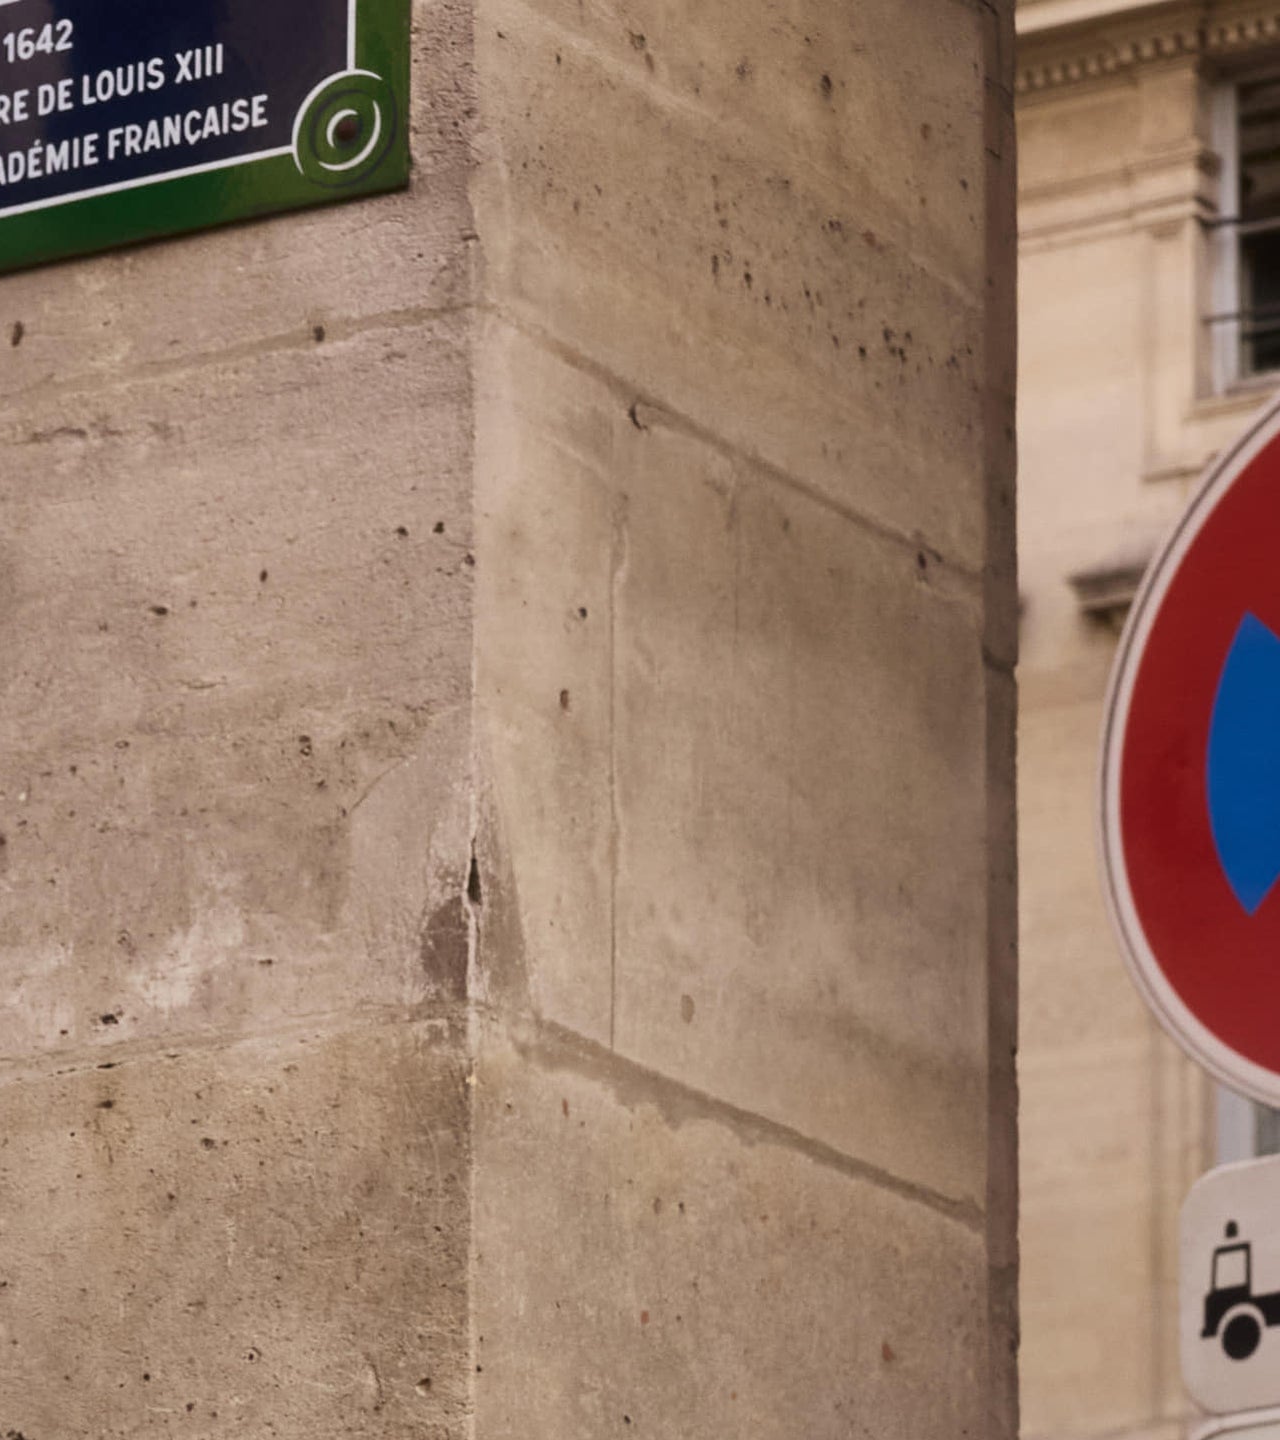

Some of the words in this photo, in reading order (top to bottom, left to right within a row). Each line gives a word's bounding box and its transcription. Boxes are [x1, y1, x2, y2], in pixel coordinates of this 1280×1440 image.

[2, 18, 74, 64] 1642
[37, 78, 74, 116] DE
[82, 57, 165, 106] LOUIS
[174, 42, 224, 84] XIII
[107, 93, 269, 160] FRANÇAISE
